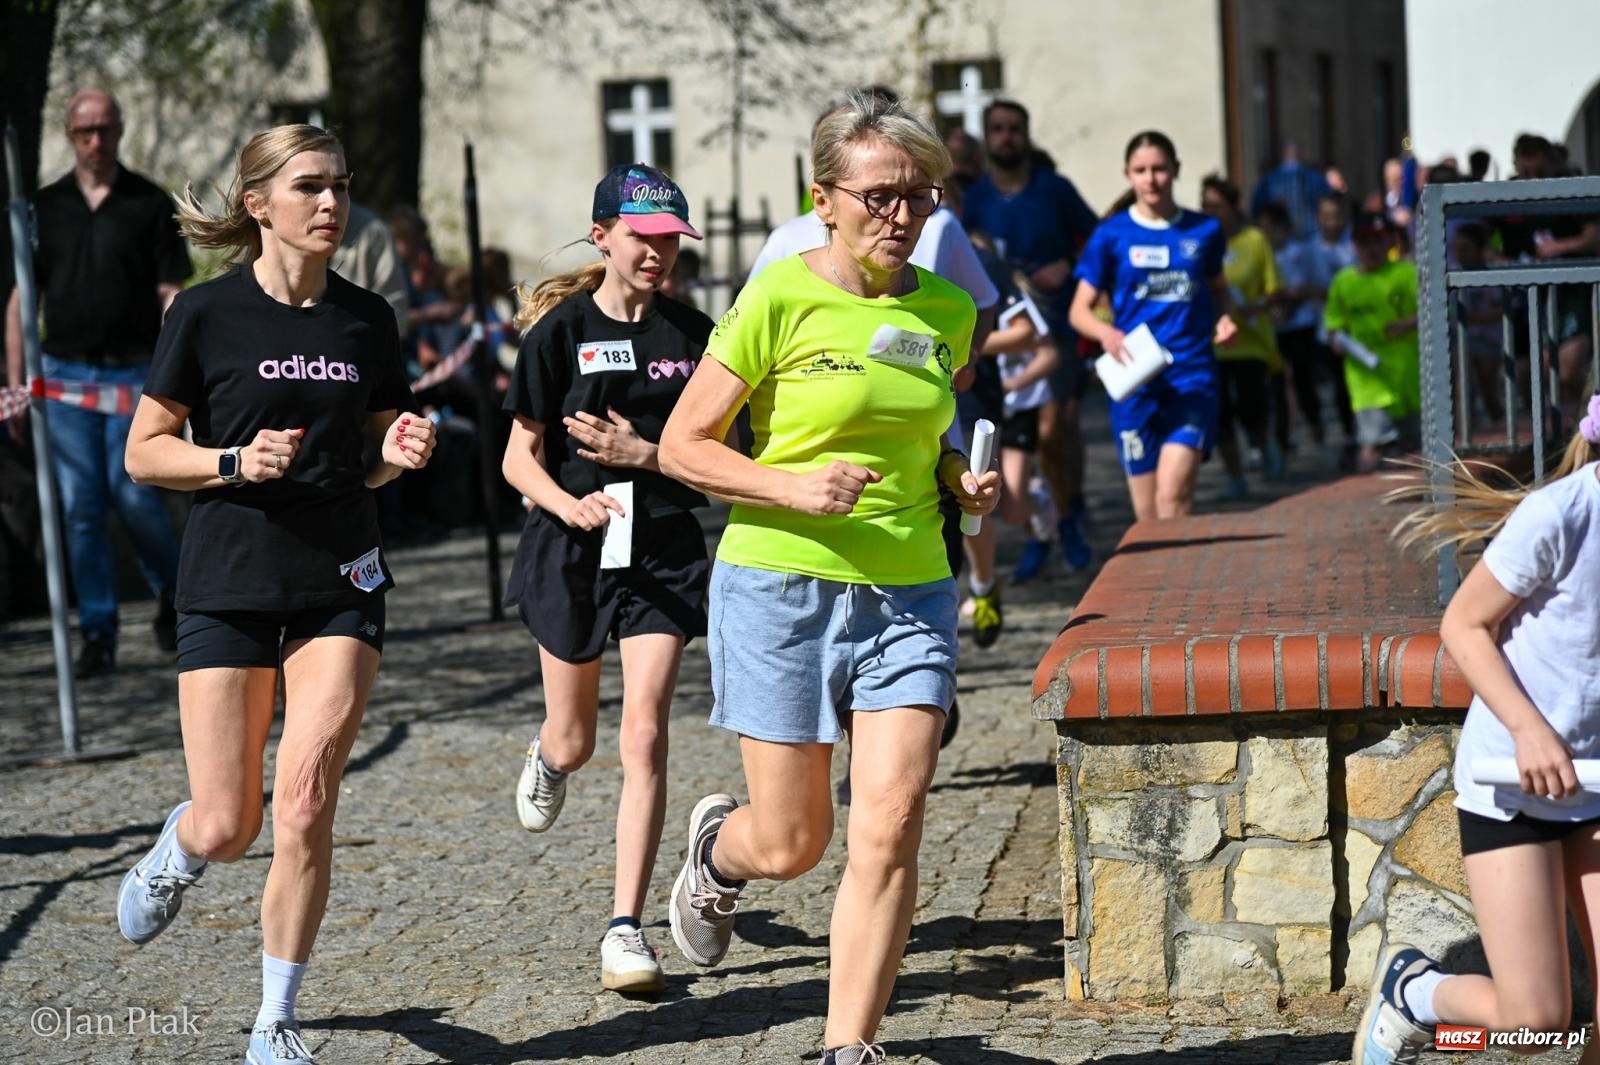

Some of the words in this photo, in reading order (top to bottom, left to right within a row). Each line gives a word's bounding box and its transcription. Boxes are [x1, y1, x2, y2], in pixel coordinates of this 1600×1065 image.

[602, 350, 631, 363] 183
[258, 355, 360, 383] adidas
[361, 560, 379, 582] 184
